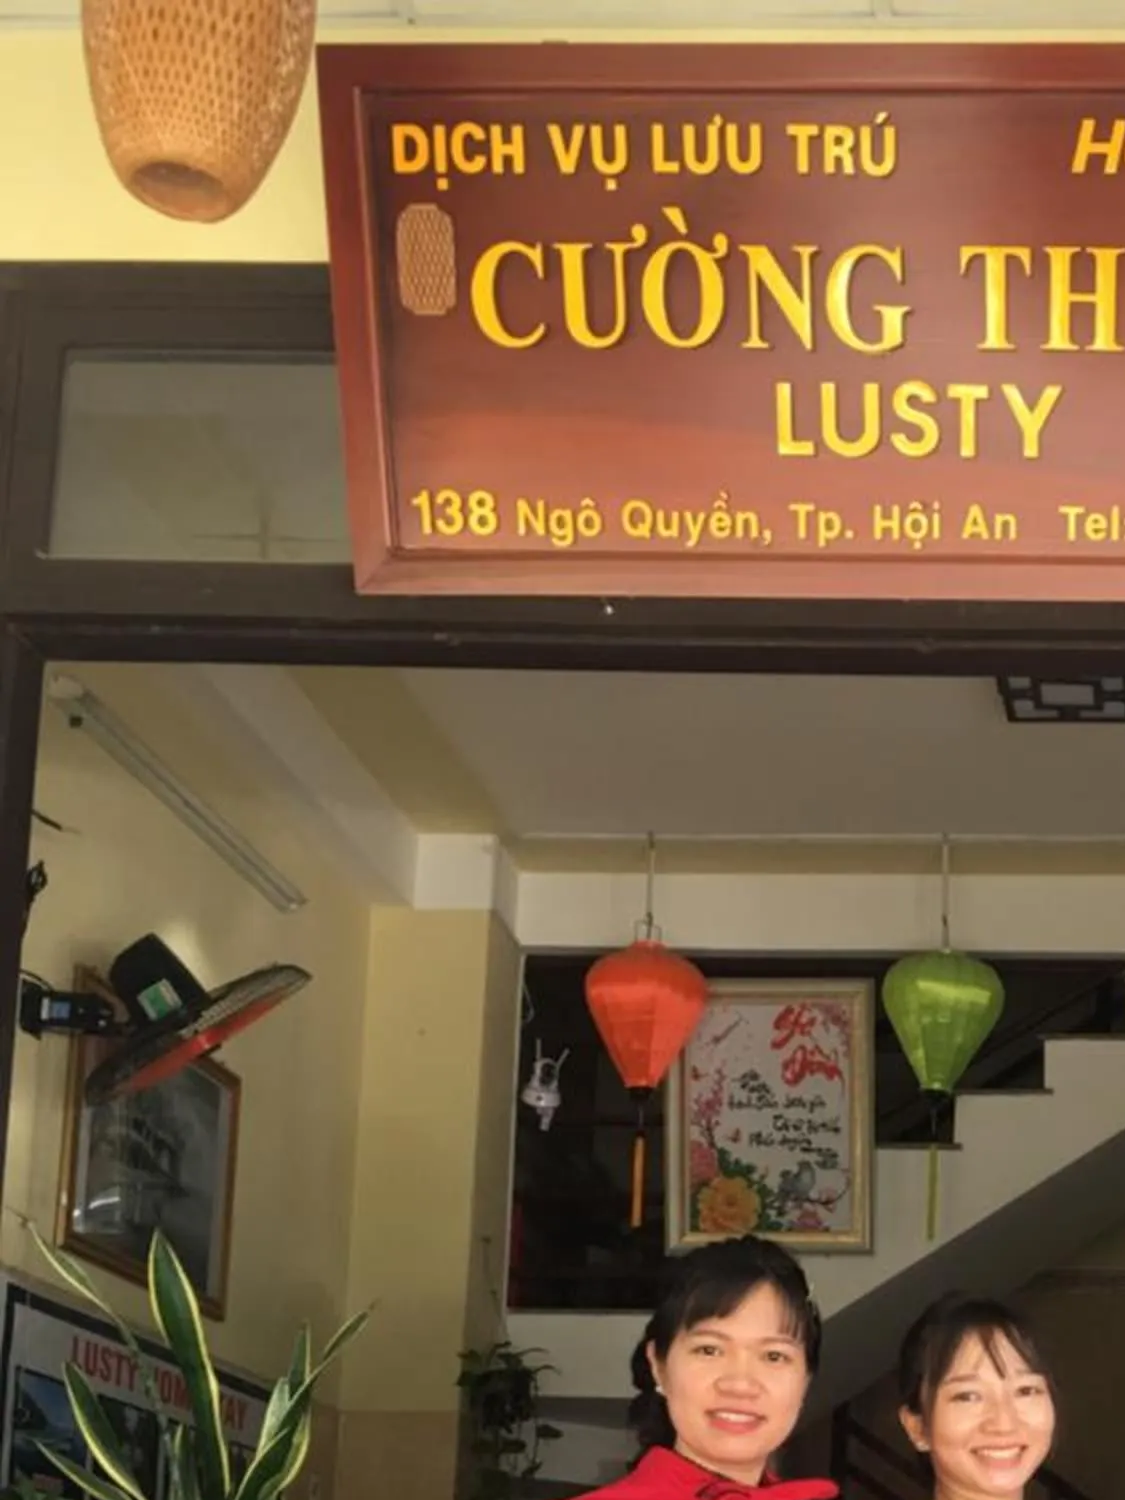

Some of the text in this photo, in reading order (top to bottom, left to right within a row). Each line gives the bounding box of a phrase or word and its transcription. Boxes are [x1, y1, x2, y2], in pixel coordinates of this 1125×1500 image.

[391, 112, 898, 192] DỊCH VỤ LƯU TRÚ
[470, 206, 912, 355] CƯỜNG
[775, 379, 1063, 460] LUSTY
[412, 488, 499, 538] 138
[515, 498, 603, 548] Ngô
[620, 491, 773, 548] Quyền,
[789, 502, 855, 547] Tp.
[871, 503, 942, 550] Hội
[961, 504, 1018, 541] An
[71, 1335, 139, 1391] LUSTY
